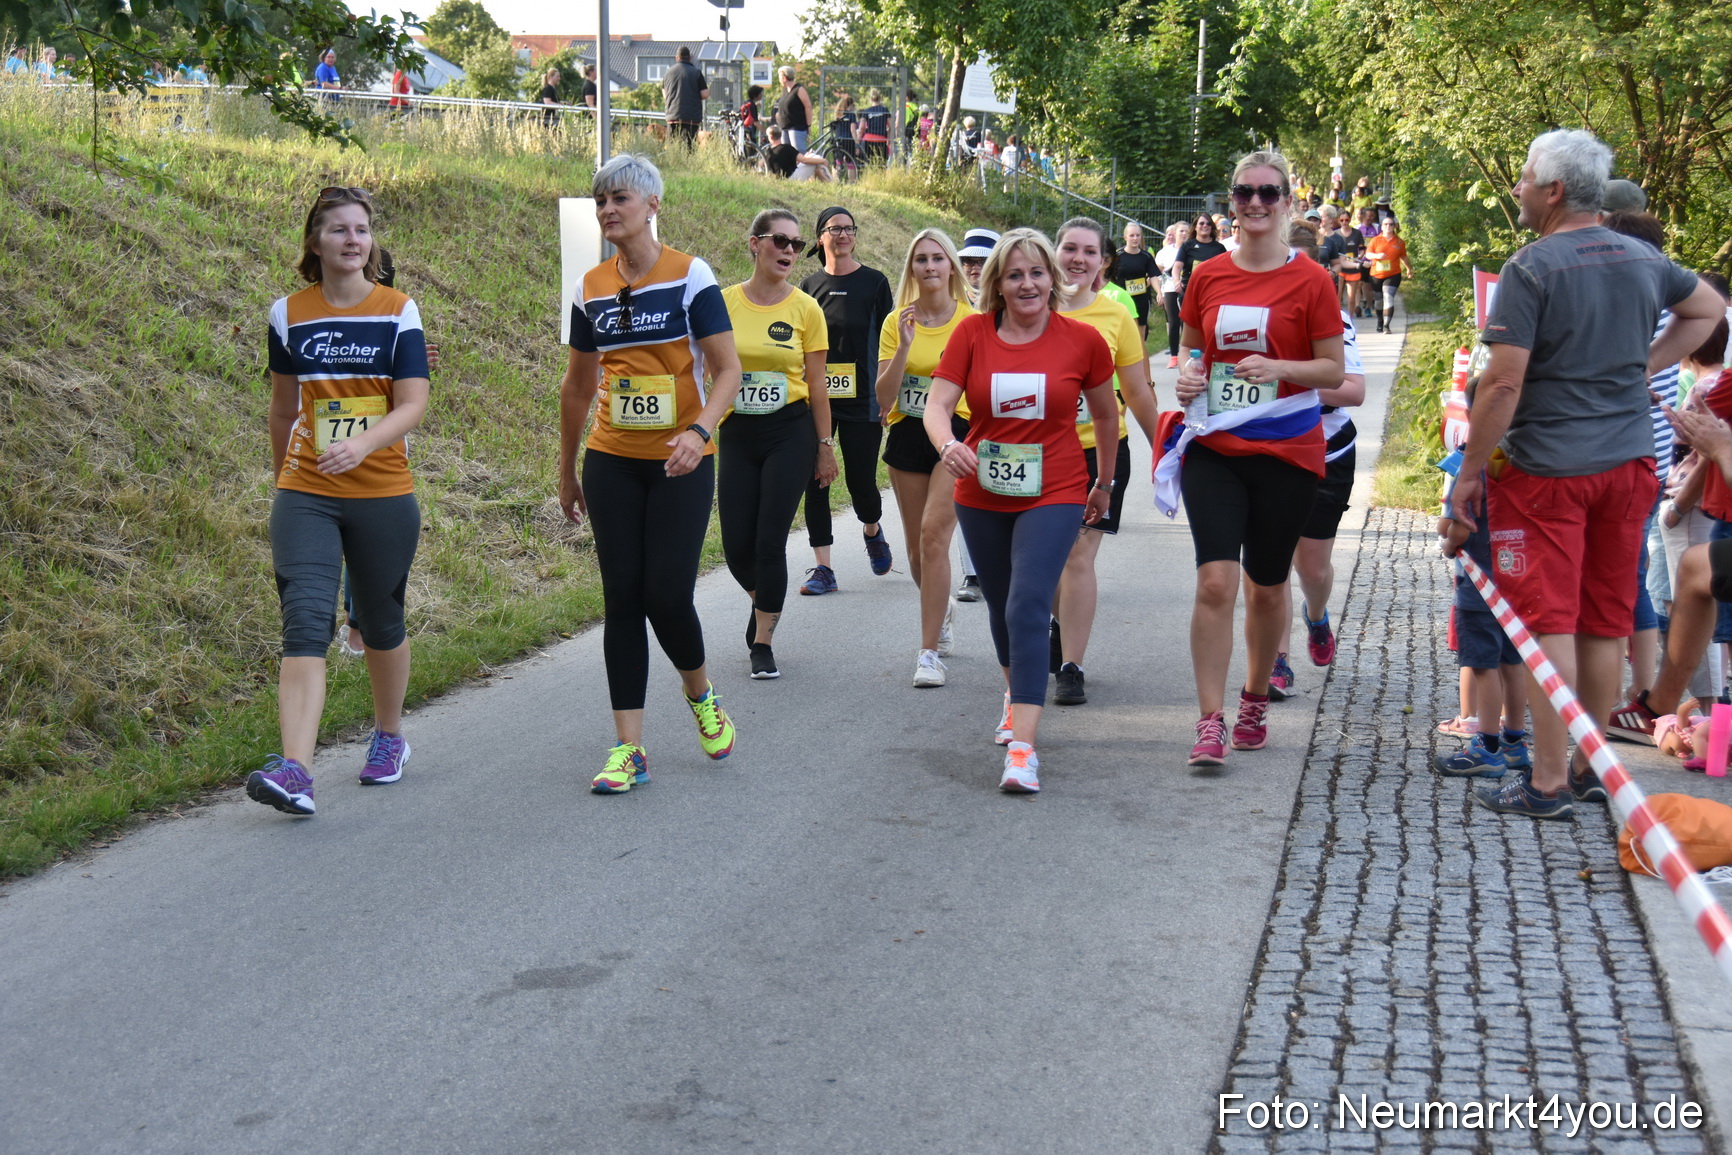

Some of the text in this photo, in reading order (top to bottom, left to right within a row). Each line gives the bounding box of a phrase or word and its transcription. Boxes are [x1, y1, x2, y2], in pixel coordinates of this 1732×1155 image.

[1128, 284, 1144, 292] 1963
[315, 342, 381, 357] Fischer
[739, 386, 781, 403] 1765
[1221, 382, 1260, 405] 510
[619, 395, 660, 416] 768
[328, 416, 369, 439] 771
[988, 460, 1026, 482] 534
